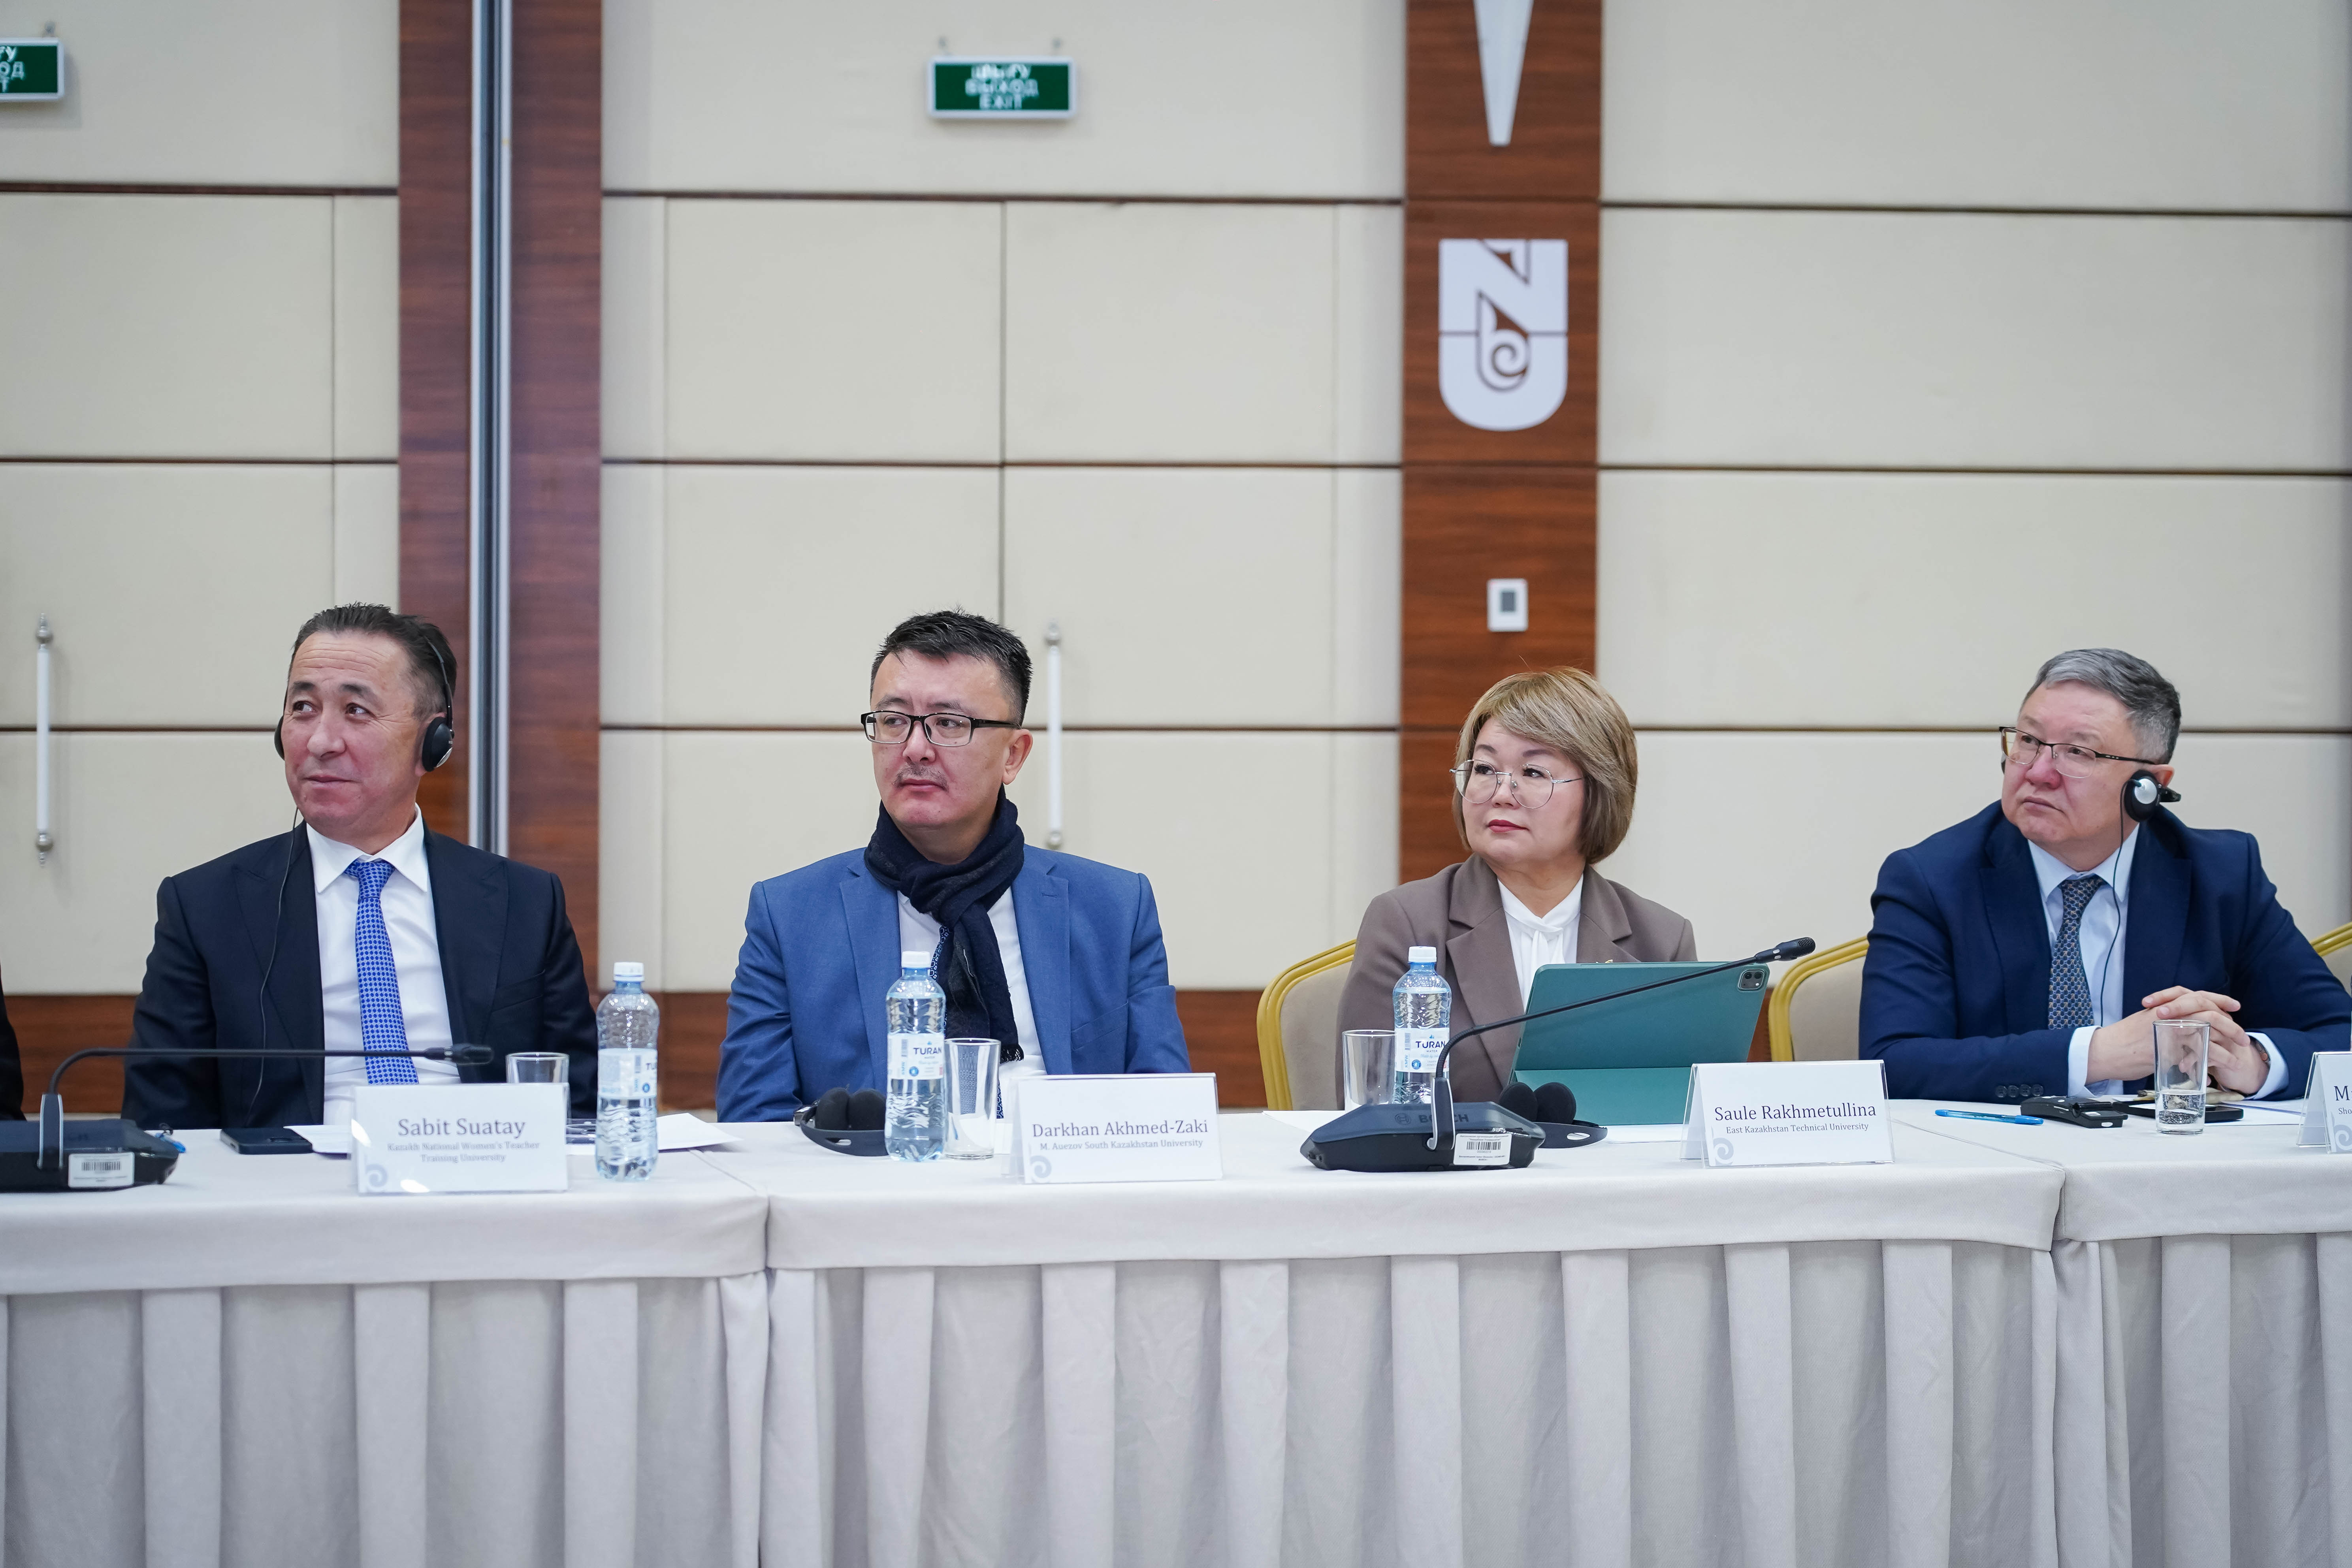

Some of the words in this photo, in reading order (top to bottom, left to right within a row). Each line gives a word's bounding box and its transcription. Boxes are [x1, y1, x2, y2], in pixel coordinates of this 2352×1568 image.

[2333, 1085, 2352, 1101] M
[1715, 1106, 1757, 1121] Saule
[1762, 1102, 1876, 1119] Rakhmetullina
[398, 1118, 450, 1136] Sabit
[456, 1118, 526, 1139] Suatay
[1032, 1122, 1099, 1137] Darkhan
[1104, 1119, 1208, 1135] Akhmed-Zaki
[1744, 1125, 1789, 1133] Kazakhstan
[1790, 1123, 1827, 1132] Technical
[1829, 1122, 1868, 1131] University
[387, 1143, 420, 1151] Kazakh
[422, 1142, 460, 1151] National
[505, 1141, 540, 1149] Teacher
[1085, 1141, 1109, 1149] South
[1111, 1140, 1158, 1148] Kazakhstan
[1160, 1139, 1203, 1148] University
[421, 1154, 458, 1163] Training
[461, 1153, 506, 1162] University
